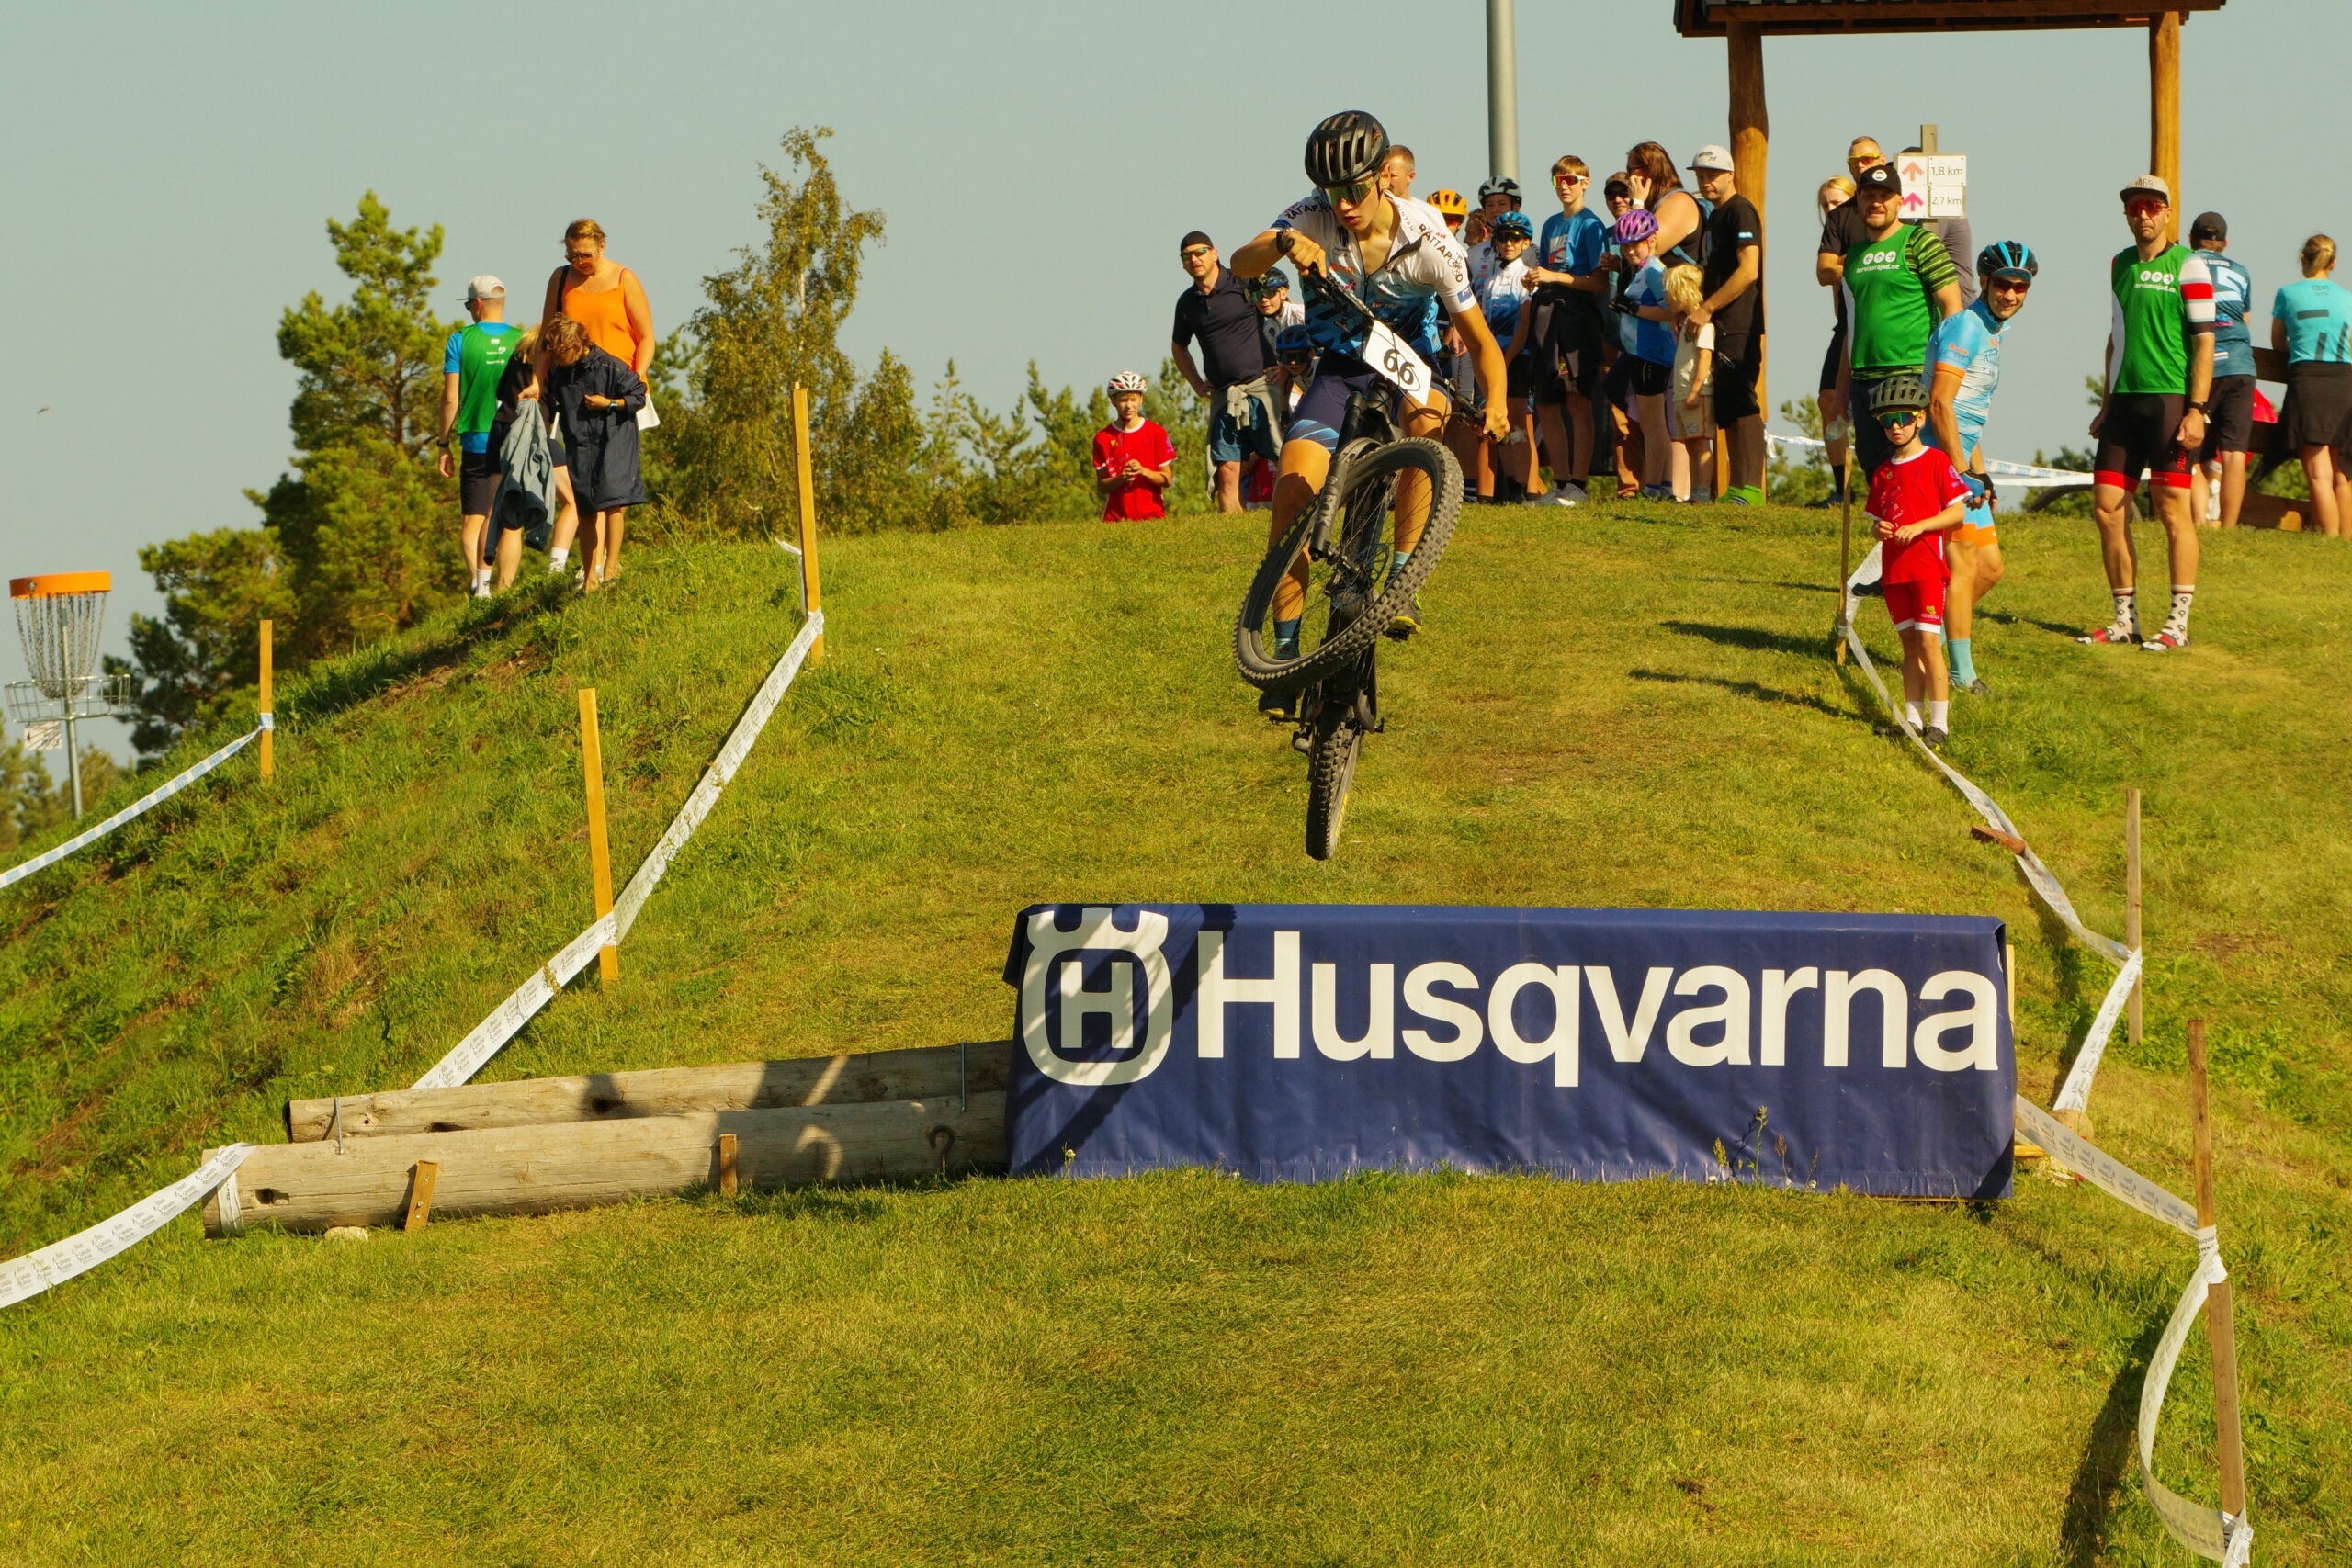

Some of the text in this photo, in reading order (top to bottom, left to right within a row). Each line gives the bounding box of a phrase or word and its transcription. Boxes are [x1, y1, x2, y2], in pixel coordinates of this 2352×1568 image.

[1931, 165, 1963, 176] 1,8 km
[1932, 196, 1962, 206] 2,7 km
[1384, 349, 1416, 385] 66
[1198, 931, 1999, 1088] Husqvarna
